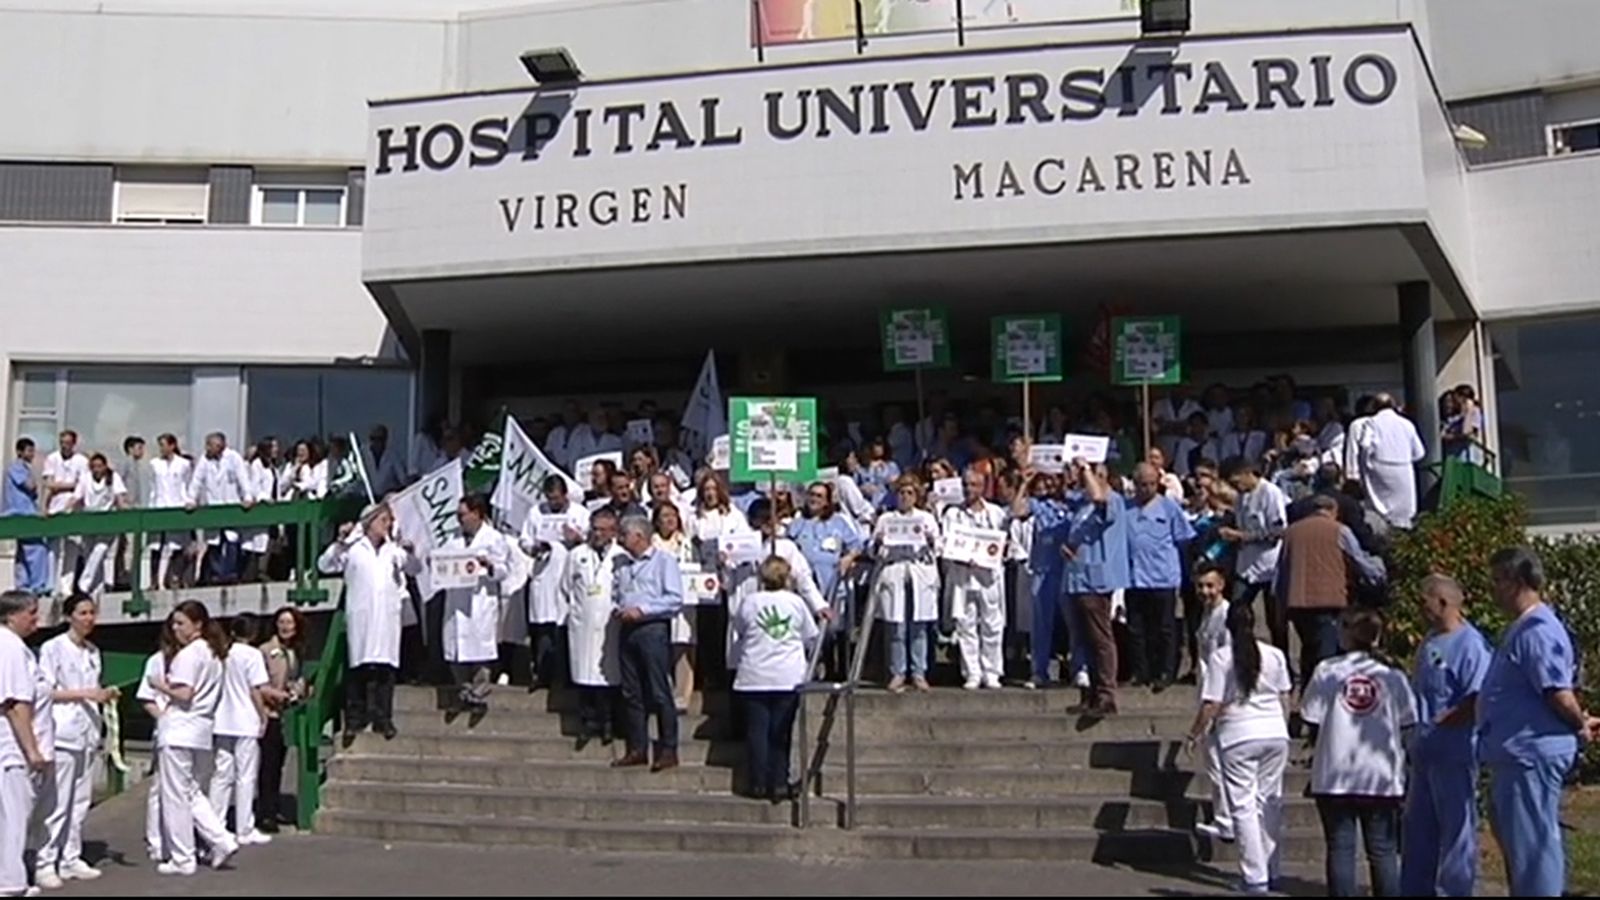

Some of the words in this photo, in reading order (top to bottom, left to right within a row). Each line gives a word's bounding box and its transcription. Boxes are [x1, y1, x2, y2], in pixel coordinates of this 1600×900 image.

[375, 97, 743, 175] HOSPITAL
[764, 52, 1399, 141] UNIVERSITARIO
[498, 184, 690, 233] VIRGEN
[952, 148, 1252, 200] MACARENA
